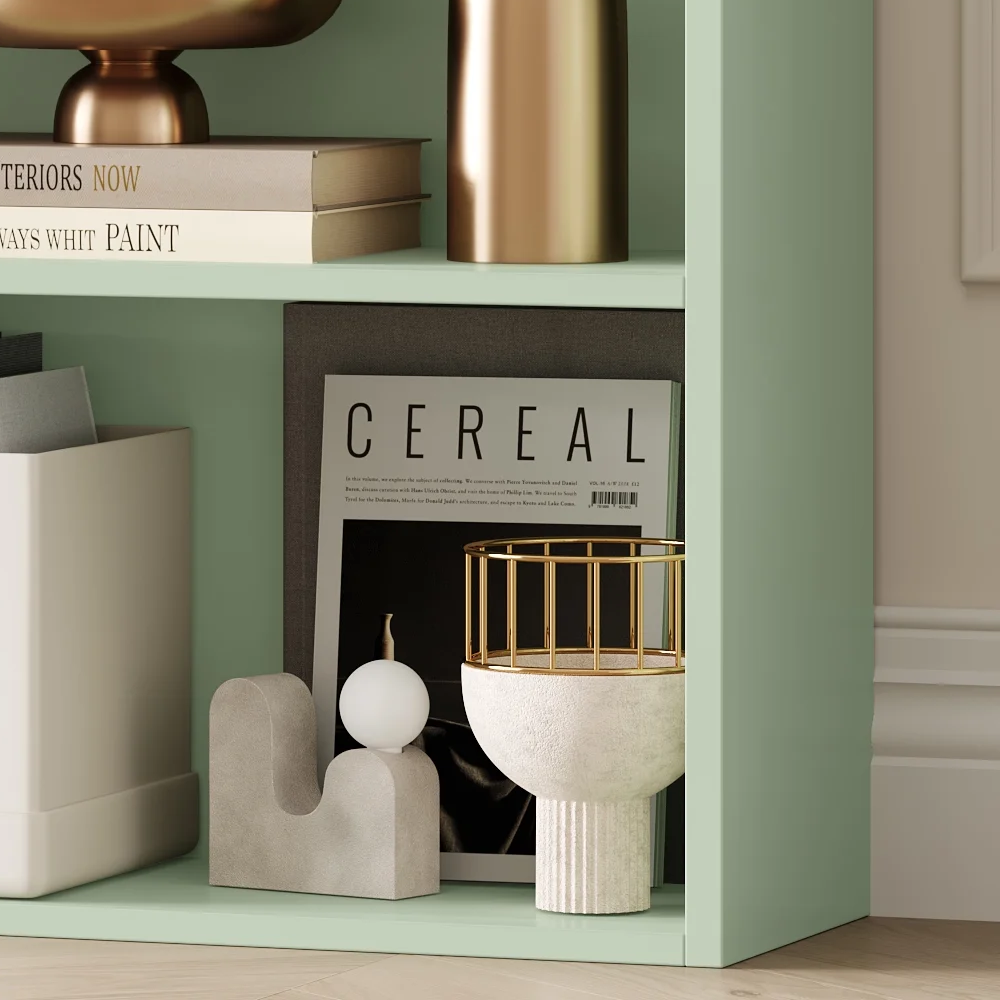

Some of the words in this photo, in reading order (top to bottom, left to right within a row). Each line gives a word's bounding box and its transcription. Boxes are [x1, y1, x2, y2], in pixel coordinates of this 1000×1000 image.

[92, 165, 142, 193] NOW
[46, 228, 96, 252] WHIT
[105, 223, 180, 253] PAINT
[346, 402, 646, 463] CEREAL
